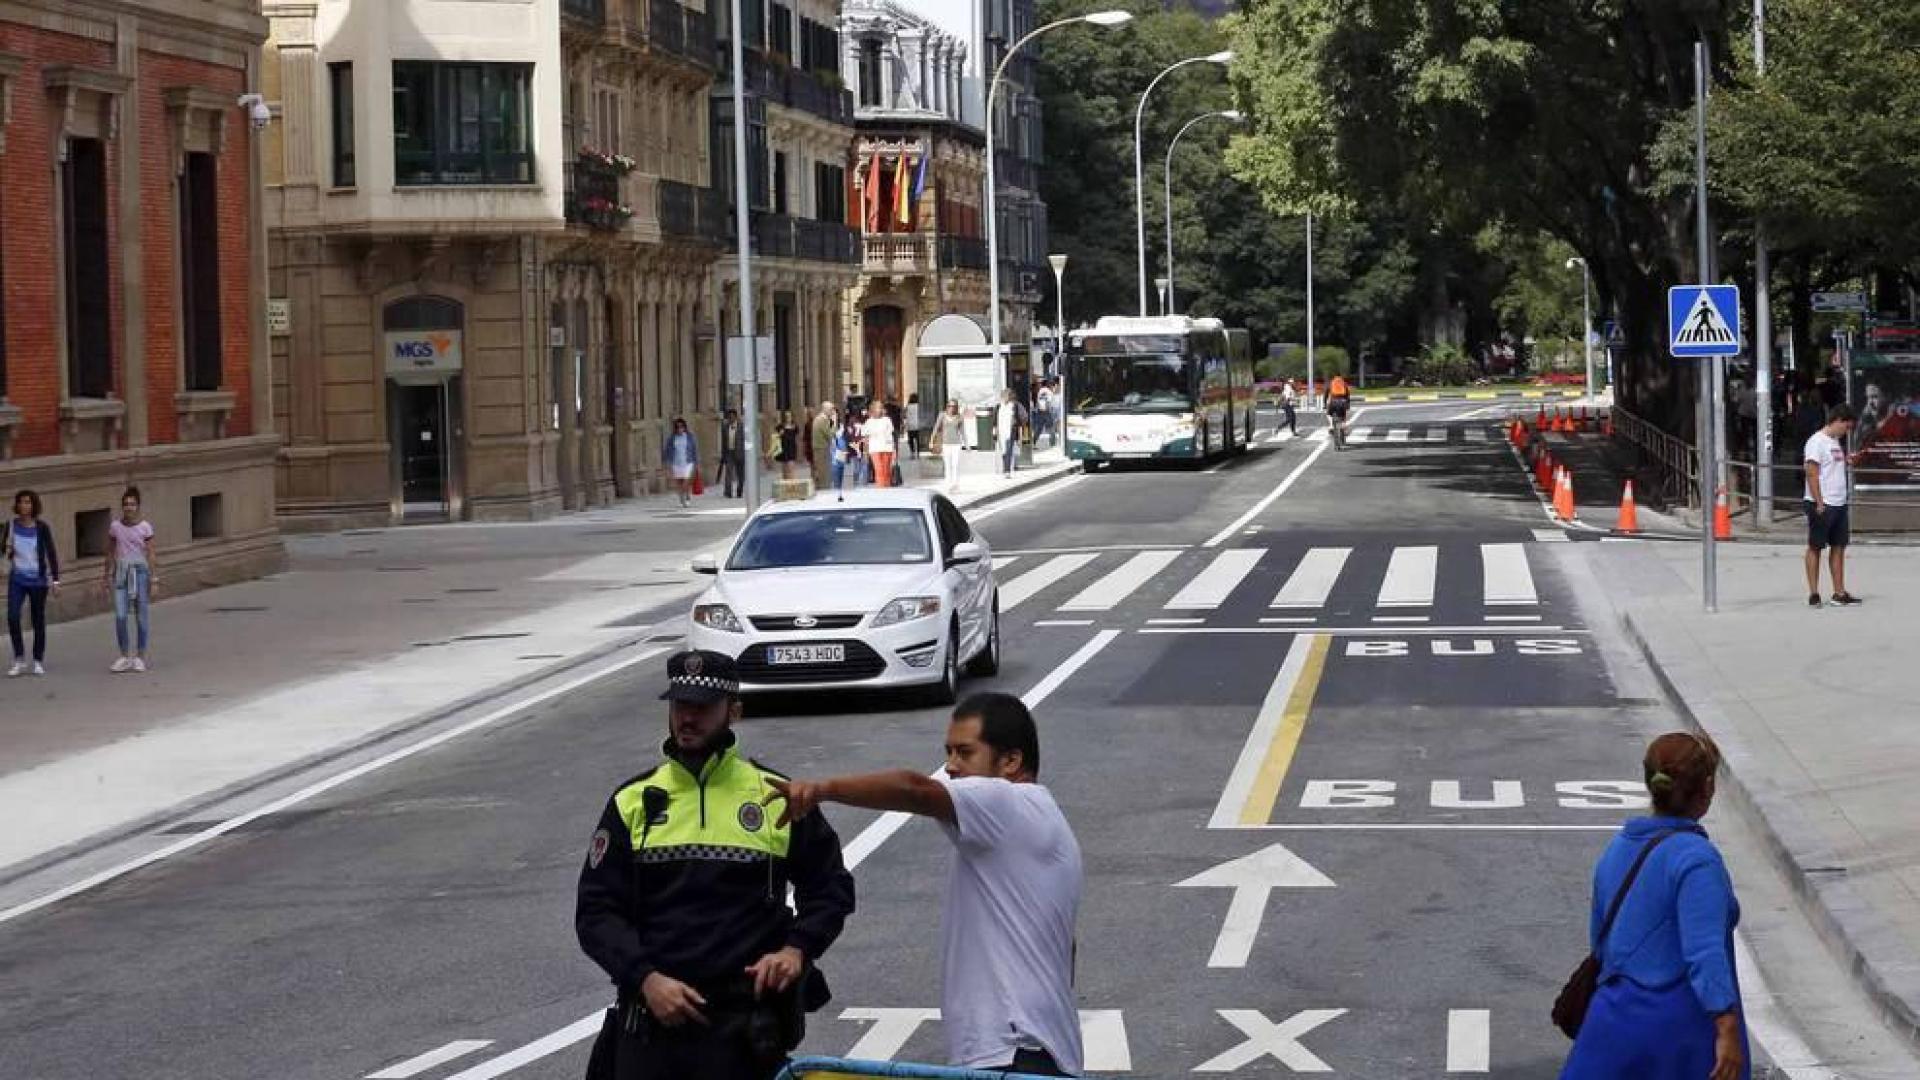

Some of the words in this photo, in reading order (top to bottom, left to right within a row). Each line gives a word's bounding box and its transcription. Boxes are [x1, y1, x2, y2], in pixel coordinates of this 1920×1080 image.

[395, 341, 433, 358] MGS
[777, 648, 811, 661] 7543
[816, 647, 841, 660] HDC
[1346, 639, 1583, 656] BUS
[1299, 780, 1652, 809] BUS
